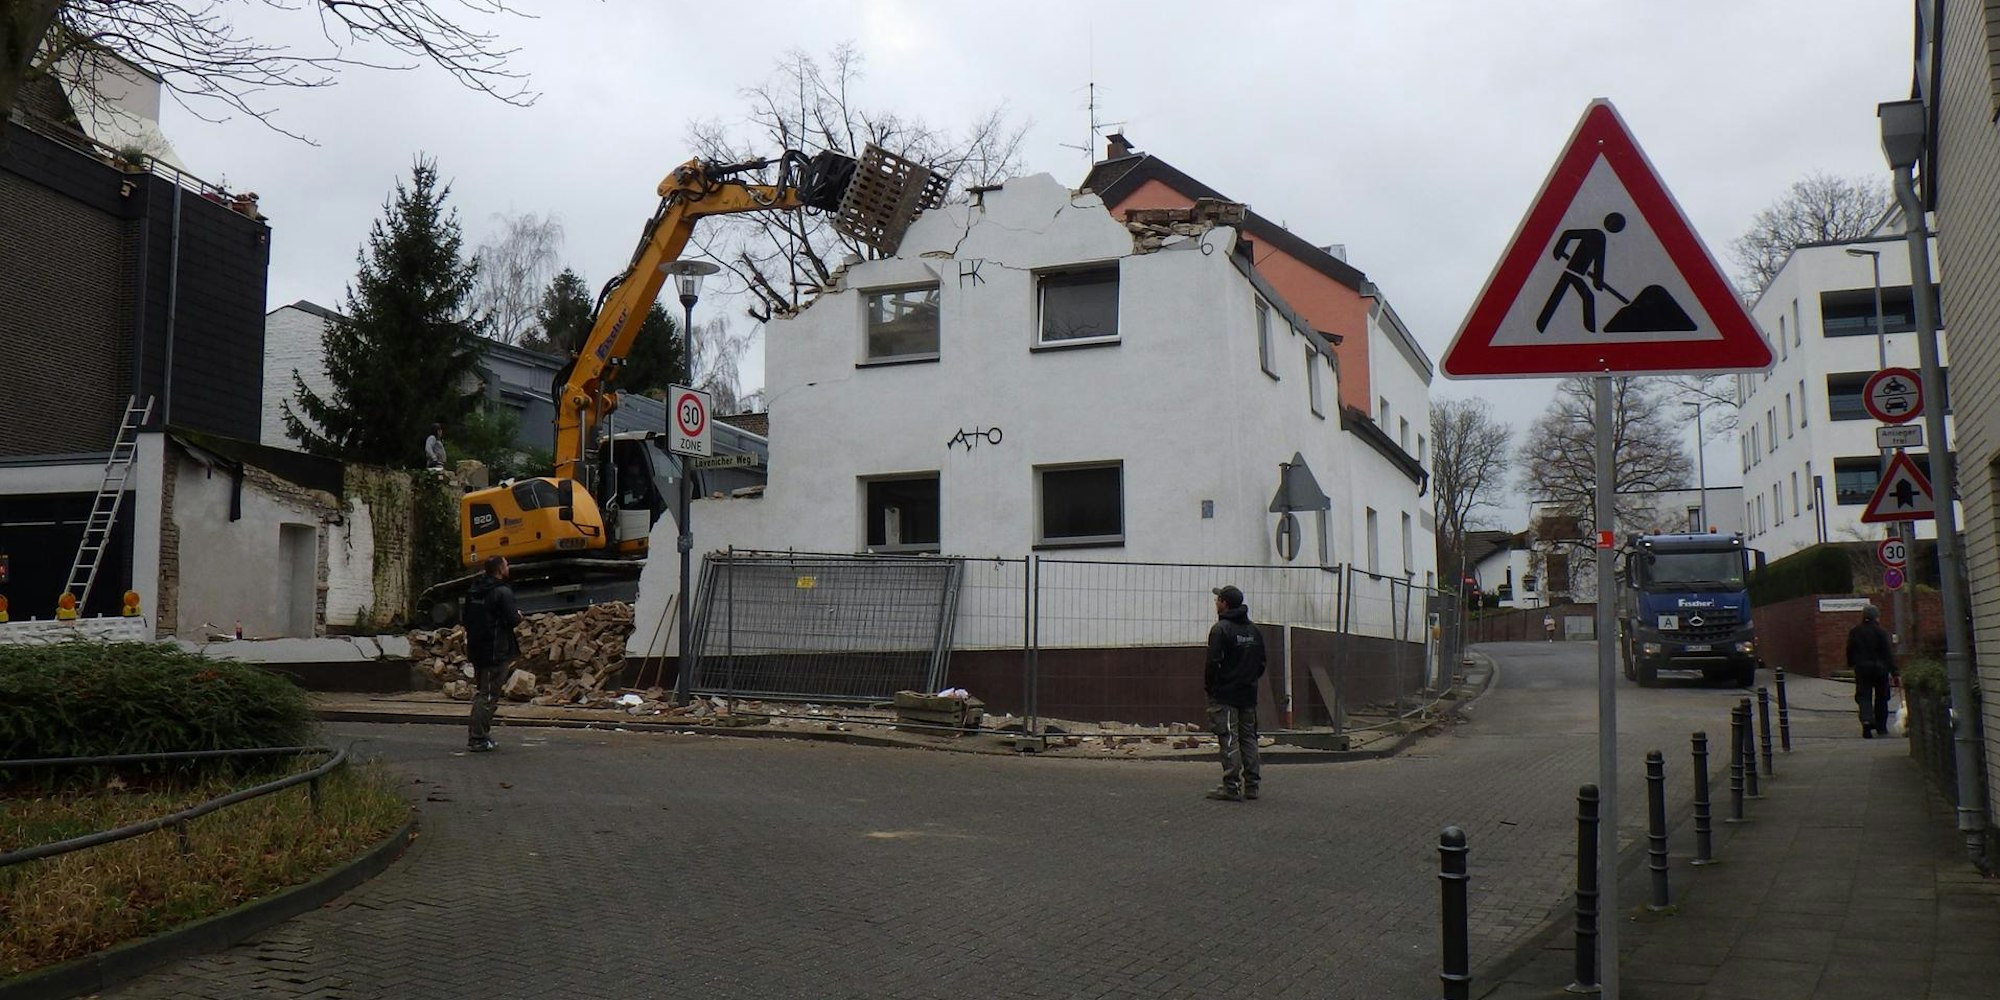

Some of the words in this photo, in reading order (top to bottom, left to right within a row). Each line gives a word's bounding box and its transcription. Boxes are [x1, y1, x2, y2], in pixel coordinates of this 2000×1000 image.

[683, 405, 699, 426] 30
[1881, 430, 1917, 438] Anlieger
[680, 438, 702, 452] ZONE
[736, 454, 751, 465] Weg
[473, 514, 493, 525] 920
[1886, 545, 1906, 560] 30
[1663, 617, 1674, 628] A
